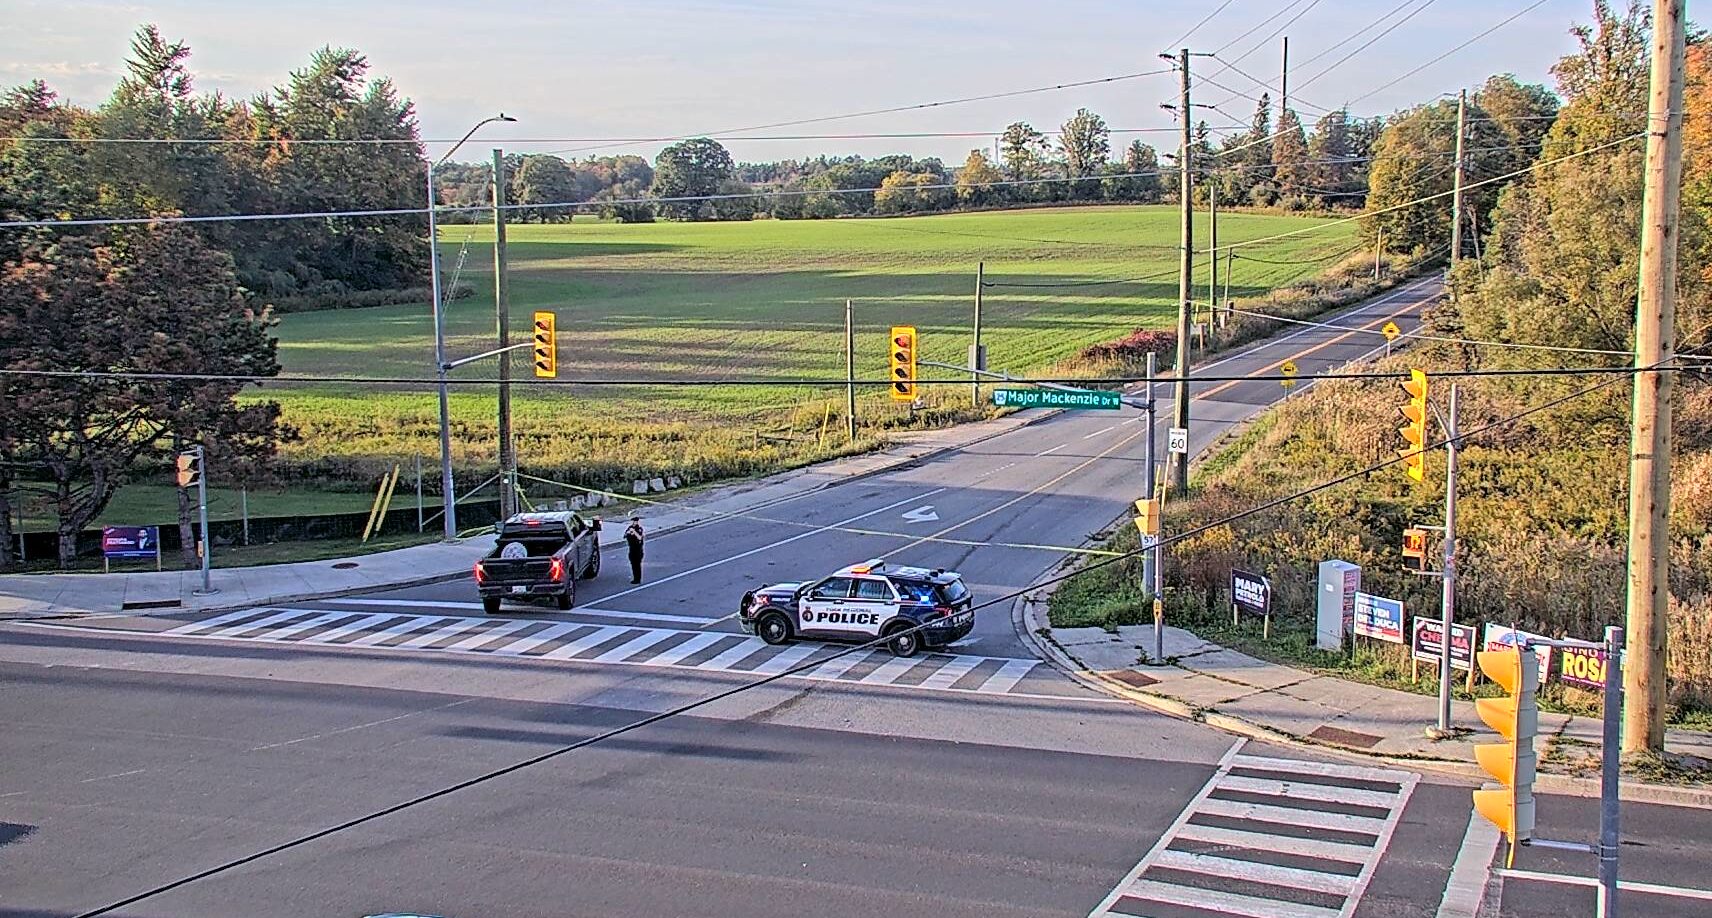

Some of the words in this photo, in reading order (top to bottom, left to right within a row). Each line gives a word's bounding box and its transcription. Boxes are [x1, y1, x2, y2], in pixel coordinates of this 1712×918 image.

[1008, 391, 1039, 405] Major
[1042, 392, 1100, 405] Mackenzie
[1102, 397, 1111, 405] Dr
[1112, 397, 1119, 405] W
[1171, 438, 1185, 449] 60
[1235, 577, 1265, 595] MARY
[816, 612, 880, 625] POLICE
[1358, 604, 1390, 619] STEVEN
[1357, 613, 1374, 625] DEL
[1374, 617, 1399, 631] DUCA
[1419, 630, 1470, 649] CHEMA
